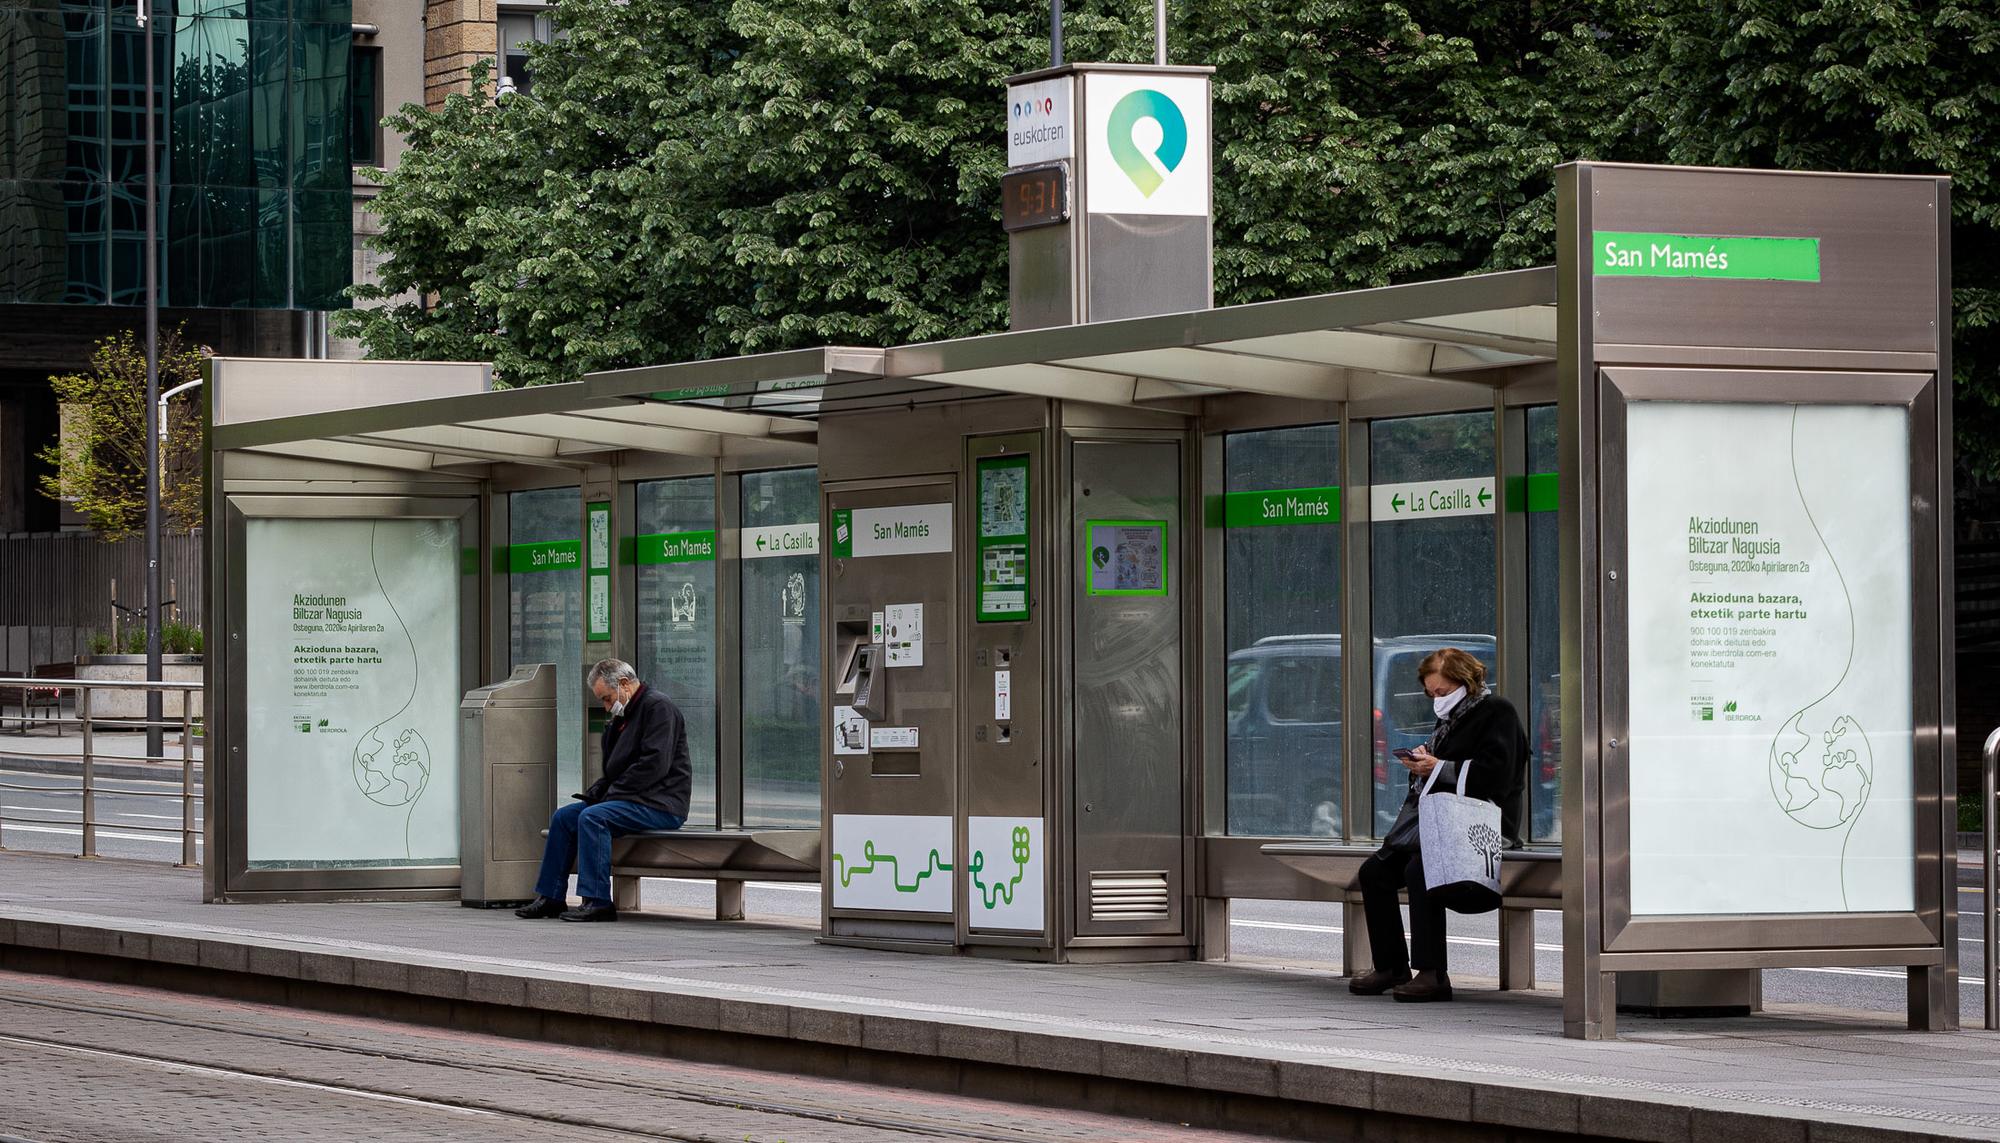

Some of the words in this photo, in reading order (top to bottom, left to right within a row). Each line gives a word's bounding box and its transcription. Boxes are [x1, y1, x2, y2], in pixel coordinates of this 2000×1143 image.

[1013, 124, 1064, 146] euskotren
[1604, 241, 1643, 268] San
[1650, 243, 1728, 270] Mamés
[1262, 498, 1283, 519] San
[1286, 495, 1329, 517] Mamés
[1410, 492, 1425, 512] La
[1429, 489, 1471, 511] Casilla
[873, 523, 892, 540] San
[894, 520, 930, 539] Mamés
[1688, 516, 1759, 534] Akziodunen
[663, 540, 679, 557] San
[680, 537, 712, 556] Mamés
[769, 533, 780, 551] La
[783, 532, 813, 550] Casilla
[1688, 536, 1729, 554] Biltzar
[1732, 537, 1781, 560] Nagusia
[532, 549, 547, 566] San
[548, 547, 577, 564] Mamés
[1689, 559, 1730, 575] Osteguna,
[1731, 560, 1760, 573] 2020ko
[1761, 560, 1799, 576] Apirilaren
[1799, 561, 1810, 573] 2a
[293, 593, 346, 607] Akziodunen
[1690, 592, 1754, 603] Akzioduna
[1758, 592, 1802, 606] bazara,
[293, 607, 324, 620] Biltzar
[326, 608, 362, 623] Nagusia
[1690, 608, 1734, 619] etxetik
[1738, 609, 1771, 621] parte
[1774, 608, 1807, 619] hartu
[325, 623, 348, 633] 2020ko
[377, 623, 385, 633] 2a
[1690, 627, 1705, 636] 900
[1707, 627, 1721, 636] 100
[1723, 627, 1738, 636] 019
[1740, 627, 1777, 636] zenbakira
[294, 645, 342, 654] Akzioduna
[345, 645, 379, 655] bazara,
[1751, 638, 1767, 647] edo
[294, 656, 327, 664] etxetik
[329, 656, 355, 666] parte
[357, 655, 382, 664] hartu
